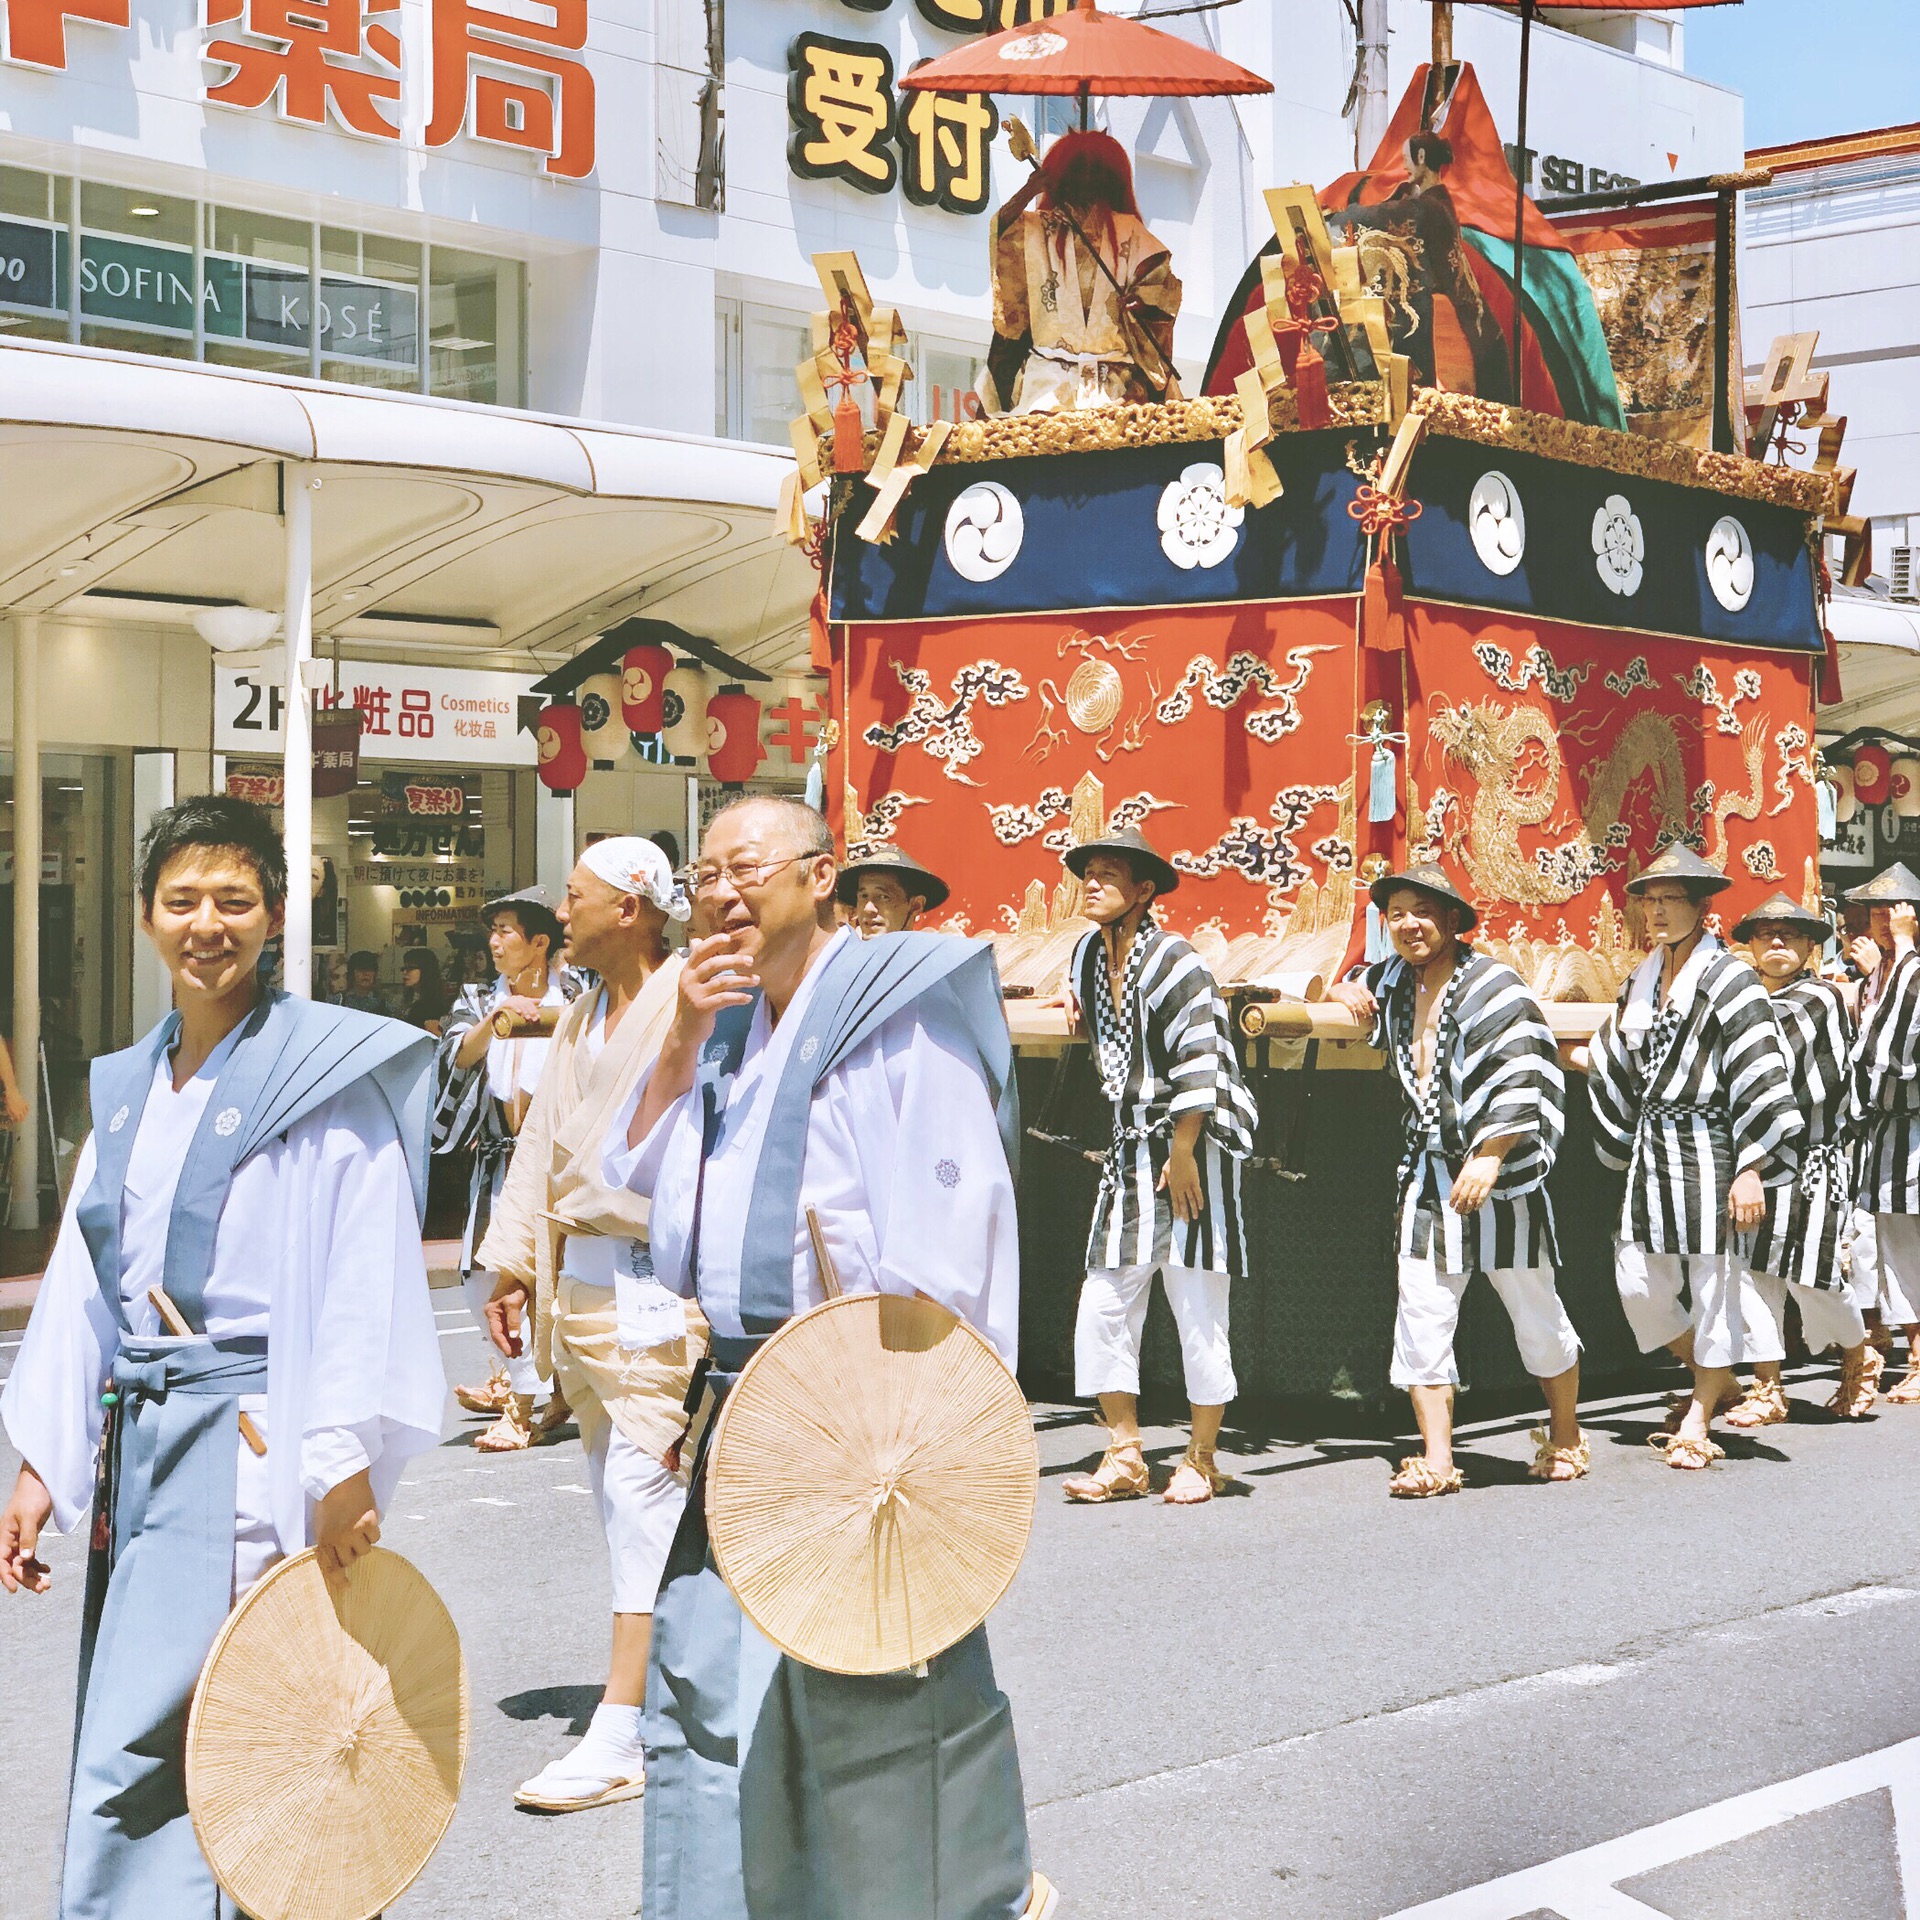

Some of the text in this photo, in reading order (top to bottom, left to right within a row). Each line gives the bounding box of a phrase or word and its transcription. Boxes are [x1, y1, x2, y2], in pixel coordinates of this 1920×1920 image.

[803, 45, 991, 202] 受付
[80, 258, 221, 313] SOFINA
[441, 693, 511, 714] Cosmetics
[454, 718, 497, 739] 化妆品
[404, 785, 464, 816] 夏祭り
[354, 866, 485, 884] 朝に預けて夜にお薬を
